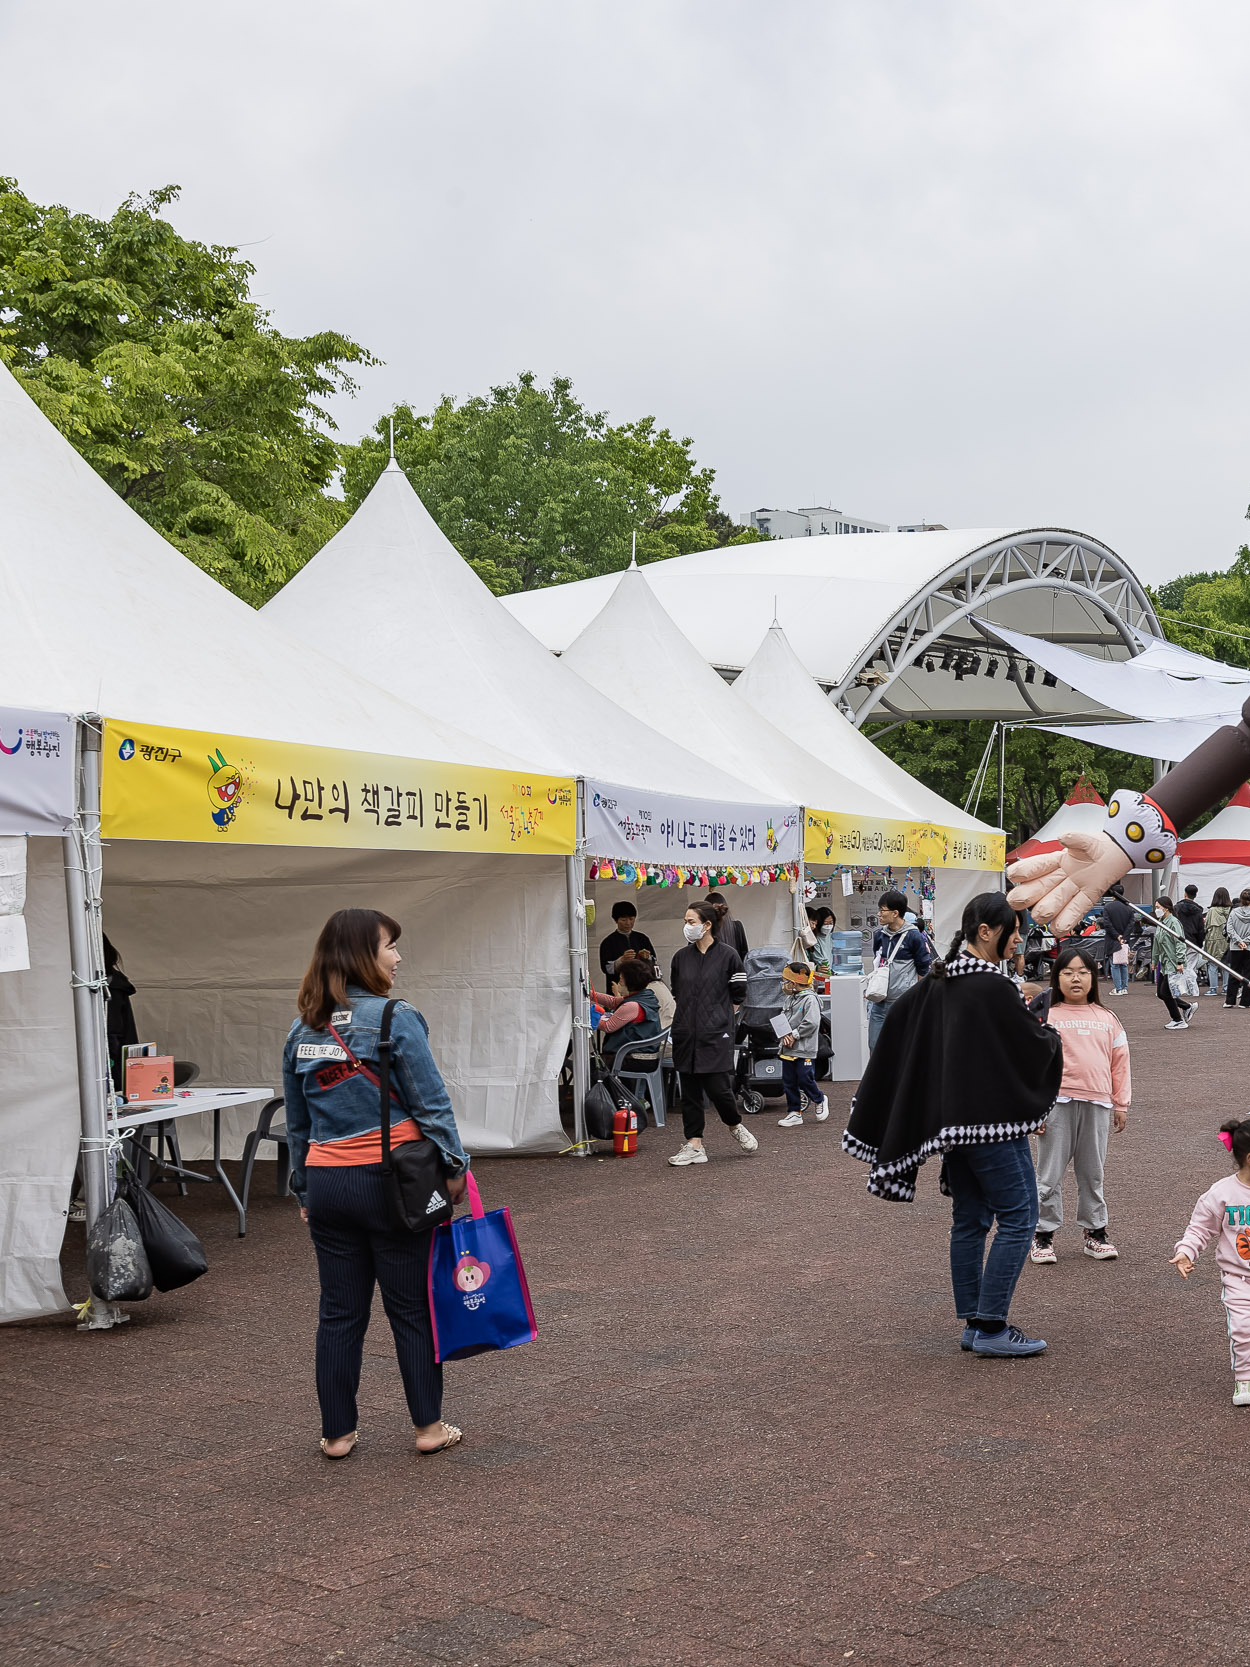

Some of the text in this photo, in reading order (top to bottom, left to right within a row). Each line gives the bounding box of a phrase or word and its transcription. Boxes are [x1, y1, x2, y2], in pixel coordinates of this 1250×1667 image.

[25, 738, 61, 758] 행복광진
[138, 744, 183, 763] 광진구
[274, 775, 488, 832] 나만의 책갈피 만들기
[600, 797, 618, 810] 광진구
[499, 804, 544, 842] 서울동화축제
[660, 818, 756, 851] 야! 나도 뜨개할 수 있다
[300, 1045, 316, 1056] FEEL
[329, 1046, 344, 1057] JOY
[425, 1199, 447, 1215] adidas
